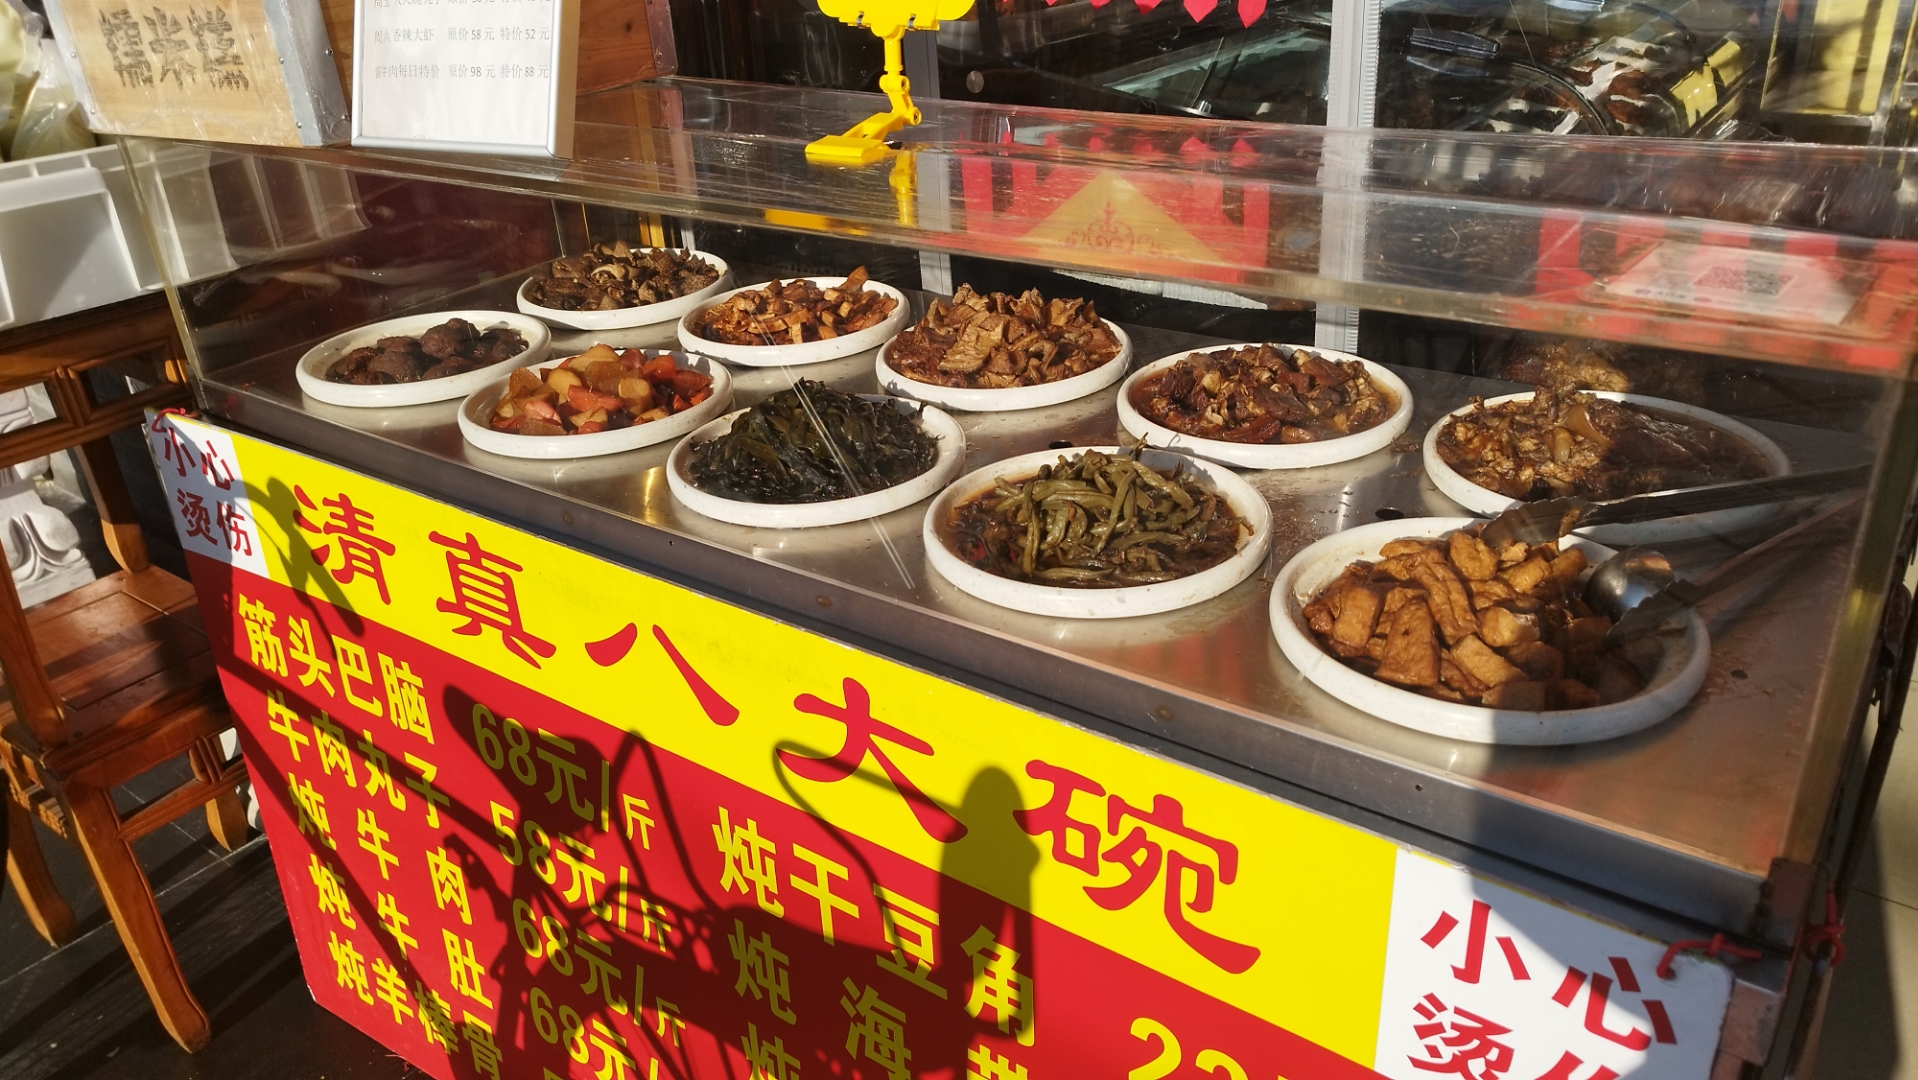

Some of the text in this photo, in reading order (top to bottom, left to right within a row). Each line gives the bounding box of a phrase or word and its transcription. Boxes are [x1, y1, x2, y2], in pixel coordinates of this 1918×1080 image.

[164, 427, 235, 490] 小心
[177, 488, 252, 557] 烫伤
[293, 485, 1261, 975] 清真八大碗
[238, 593, 435, 745] 筋头巴脑
[472, 703, 656, 851] 68元/斤
[711, 806, 1035, 1047] 炖干豆角
[267, 689, 451, 829] 牛肉丸子
[490, 800, 672, 953] 58元/斤
[512, 898, 686, 1048] 68元/斤
[1420, 899, 1678, 1051] 小心
